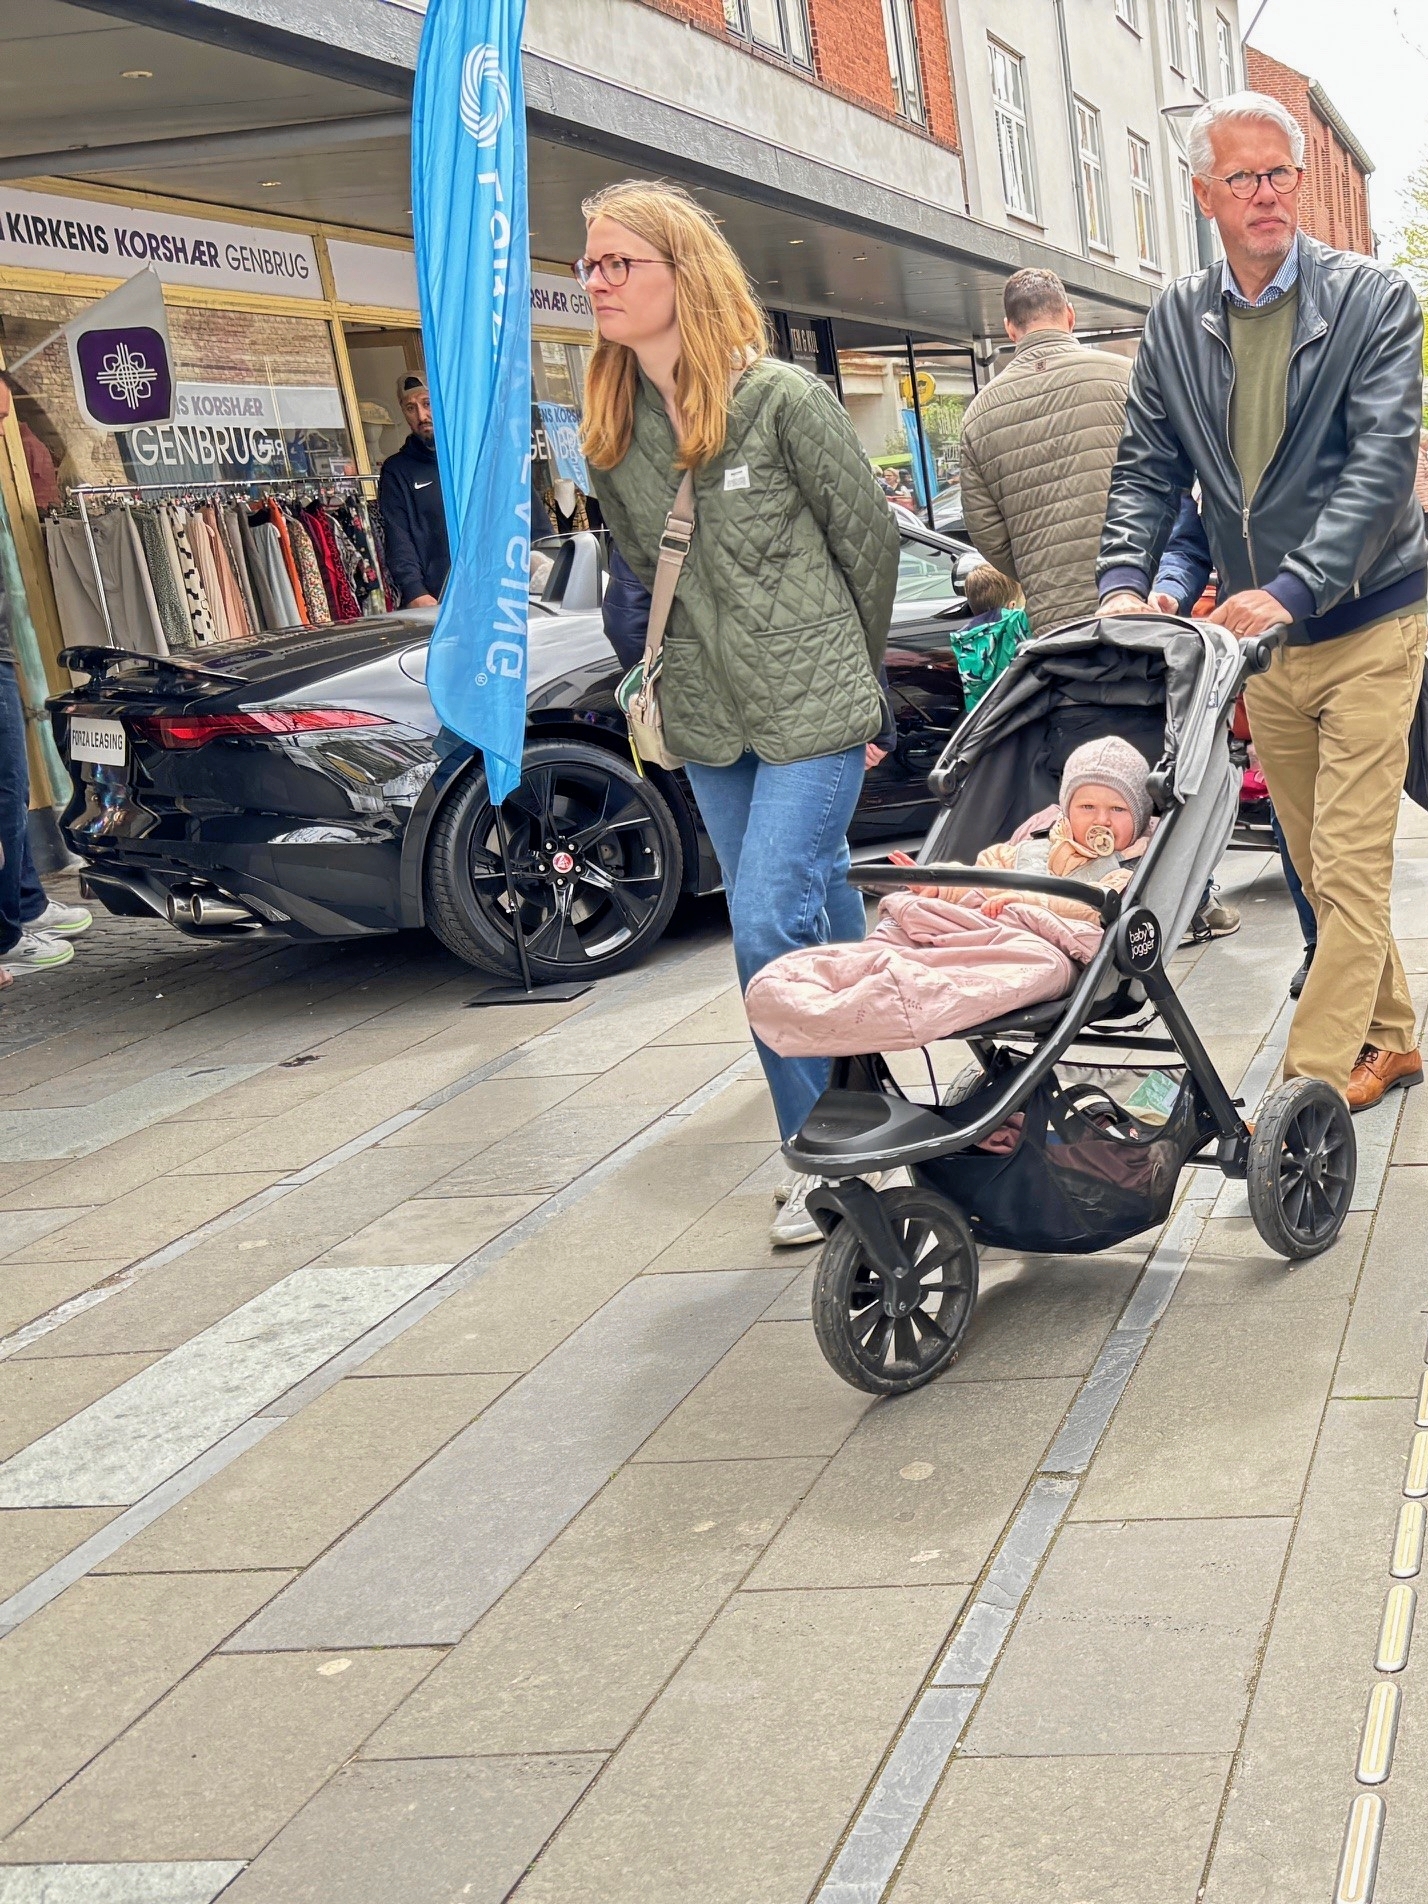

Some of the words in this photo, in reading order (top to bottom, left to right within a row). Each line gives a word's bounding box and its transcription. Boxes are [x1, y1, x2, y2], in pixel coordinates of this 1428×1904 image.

[5, 212, 109, 255] KIRKENS
[113, 227, 222, 269] KORSHÆR
[225, 243, 310, 279] GENBRUG
[190, 395, 265, 417] KORSHÆR
[131, 425, 272, 466] GENBRUG
[72, 729, 90, 747] FORZA
[90, 731, 123, 750] LEASING
[1129, 928, 1148, 943] baby
[1131, 938, 1155, 960] jogger
